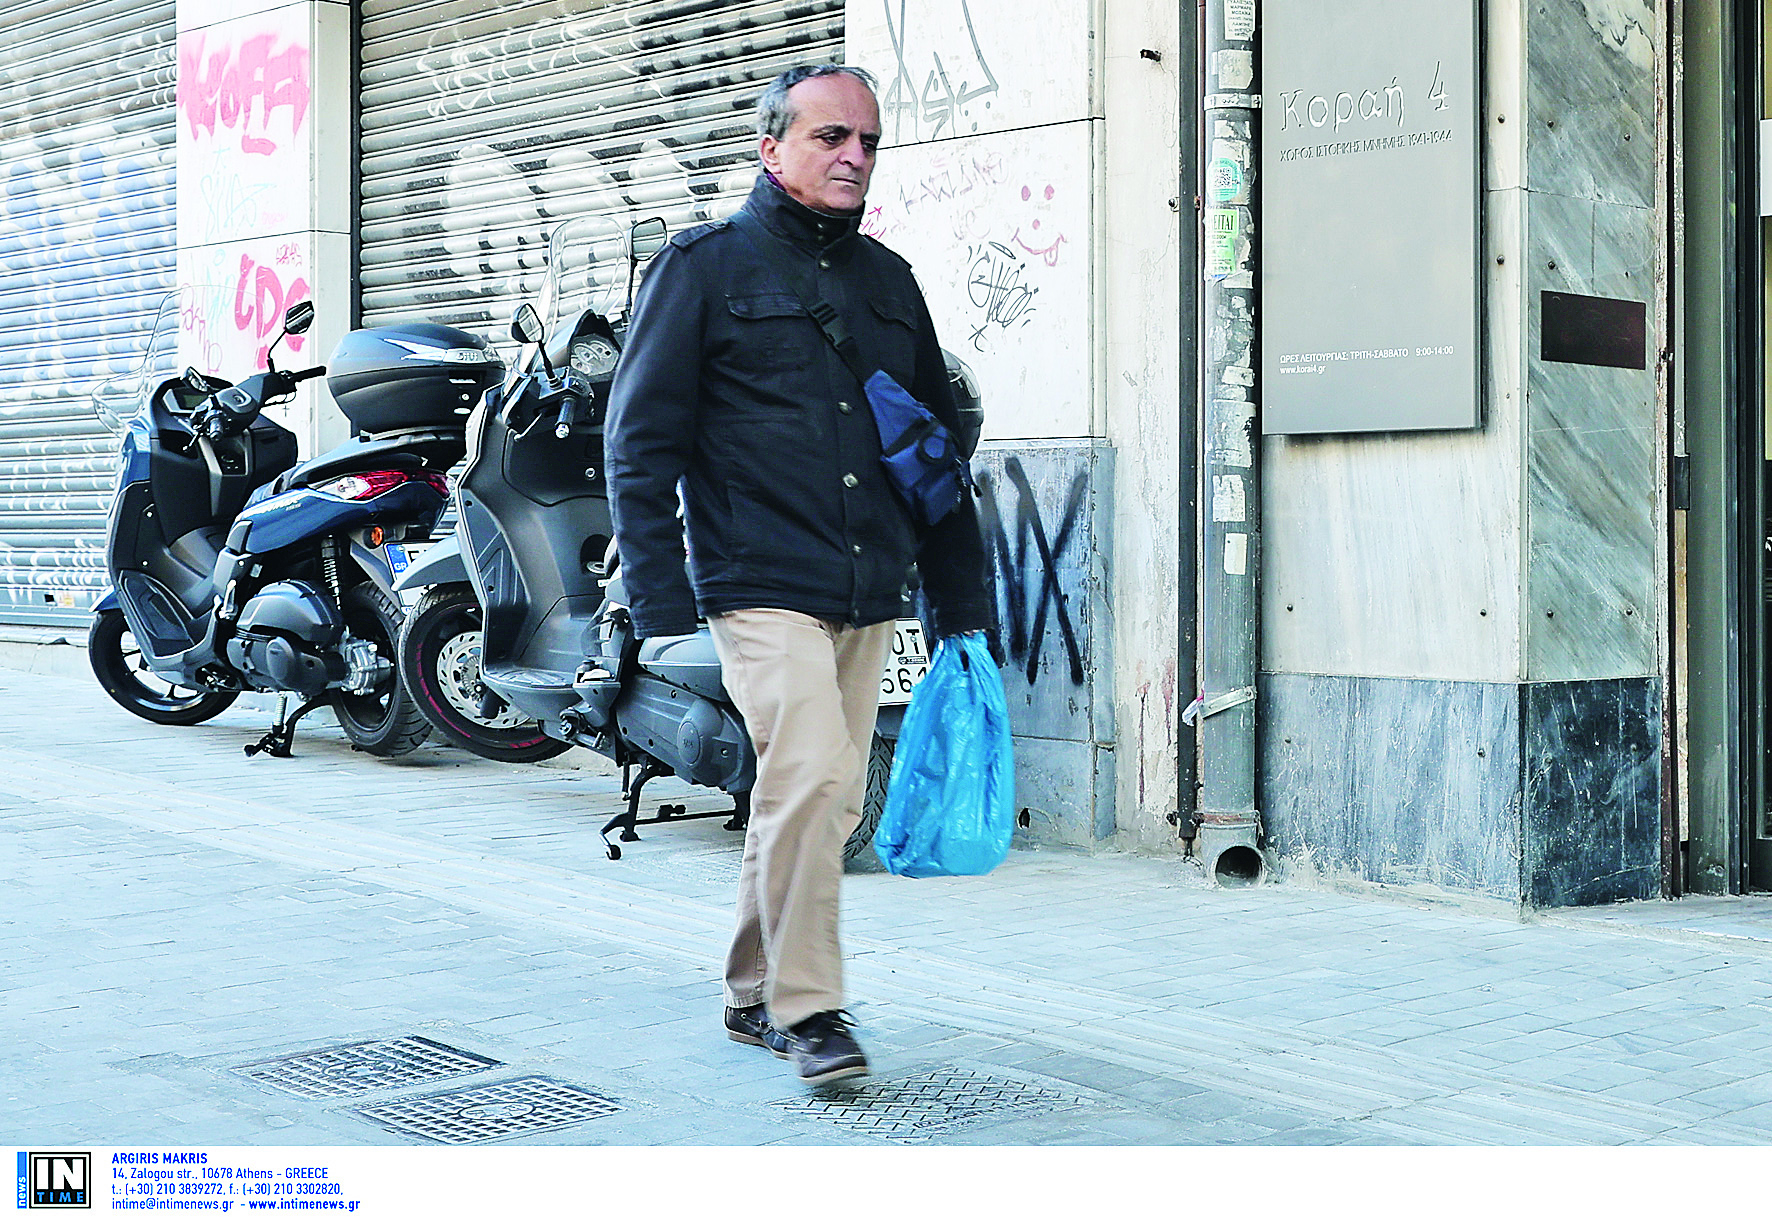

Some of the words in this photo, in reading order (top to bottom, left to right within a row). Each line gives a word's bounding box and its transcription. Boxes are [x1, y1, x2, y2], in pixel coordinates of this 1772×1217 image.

[1280, 76, 1405, 134] Κοραή
[1427, 60, 1450, 111] 4
[1280, 146, 1314, 162] ΧΩΡΟΣ
[1280, 354, 1300, 364] ΩΡΕΣ
[1280, 364, 1326, 375] www.korai4.gr
[892, 628, 920, 655] OT
